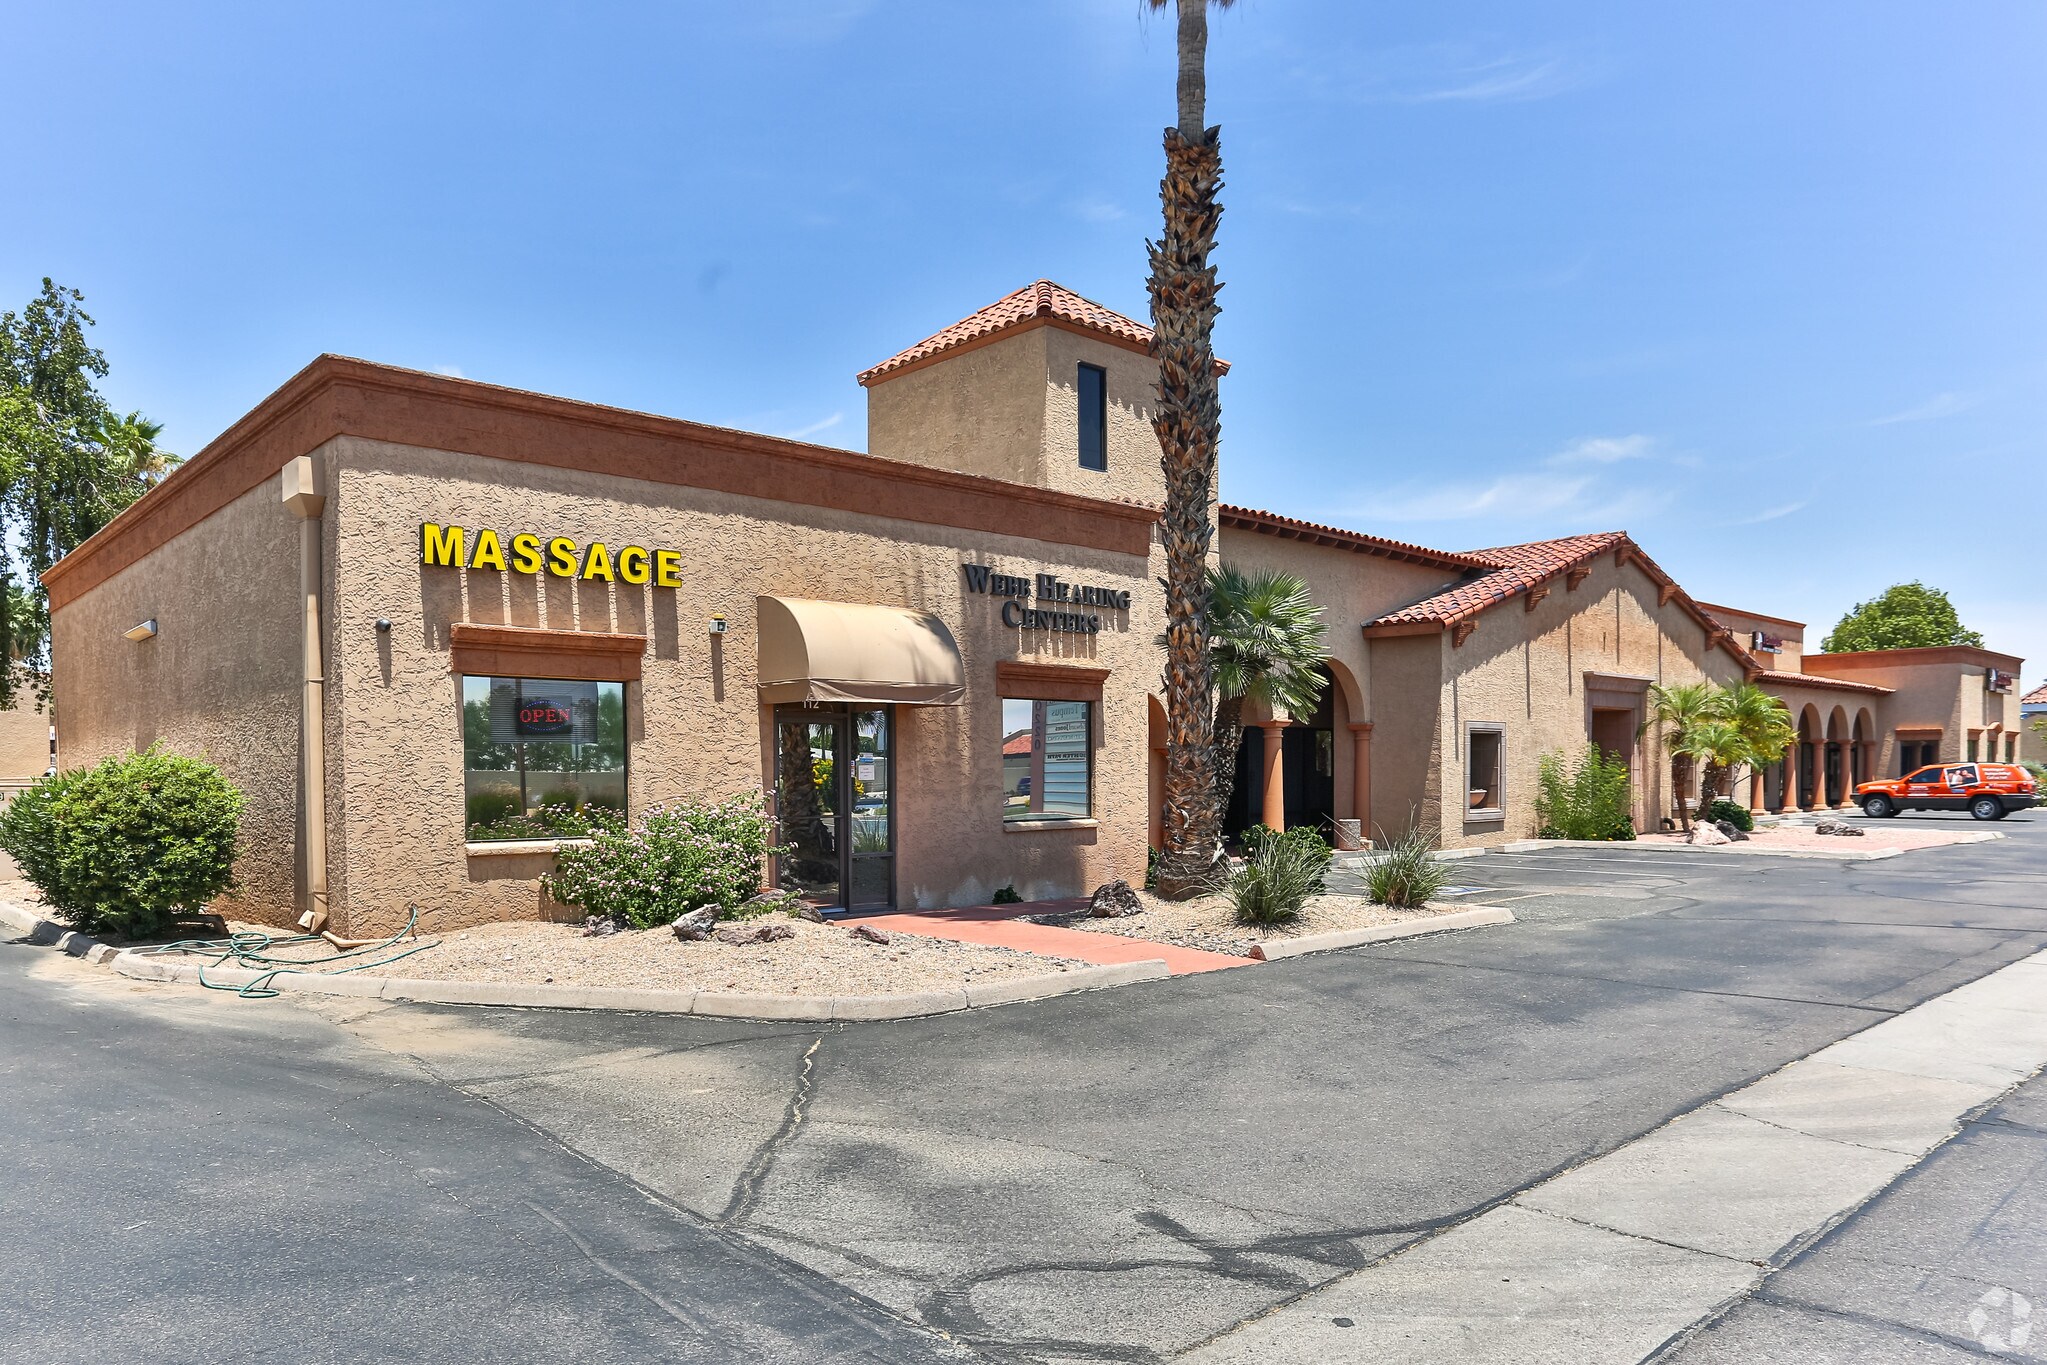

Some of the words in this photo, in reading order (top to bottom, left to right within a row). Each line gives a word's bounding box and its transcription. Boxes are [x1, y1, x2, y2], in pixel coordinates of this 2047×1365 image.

[419, 521, 683, 588] MASSAGE
[962, 564, 1031, 598] WEBB
[1035, 573, 1131, 611] HEARING
[1002, 600, 1099, 635] CENTERS
[519, 707, 571, 723] OPEN
